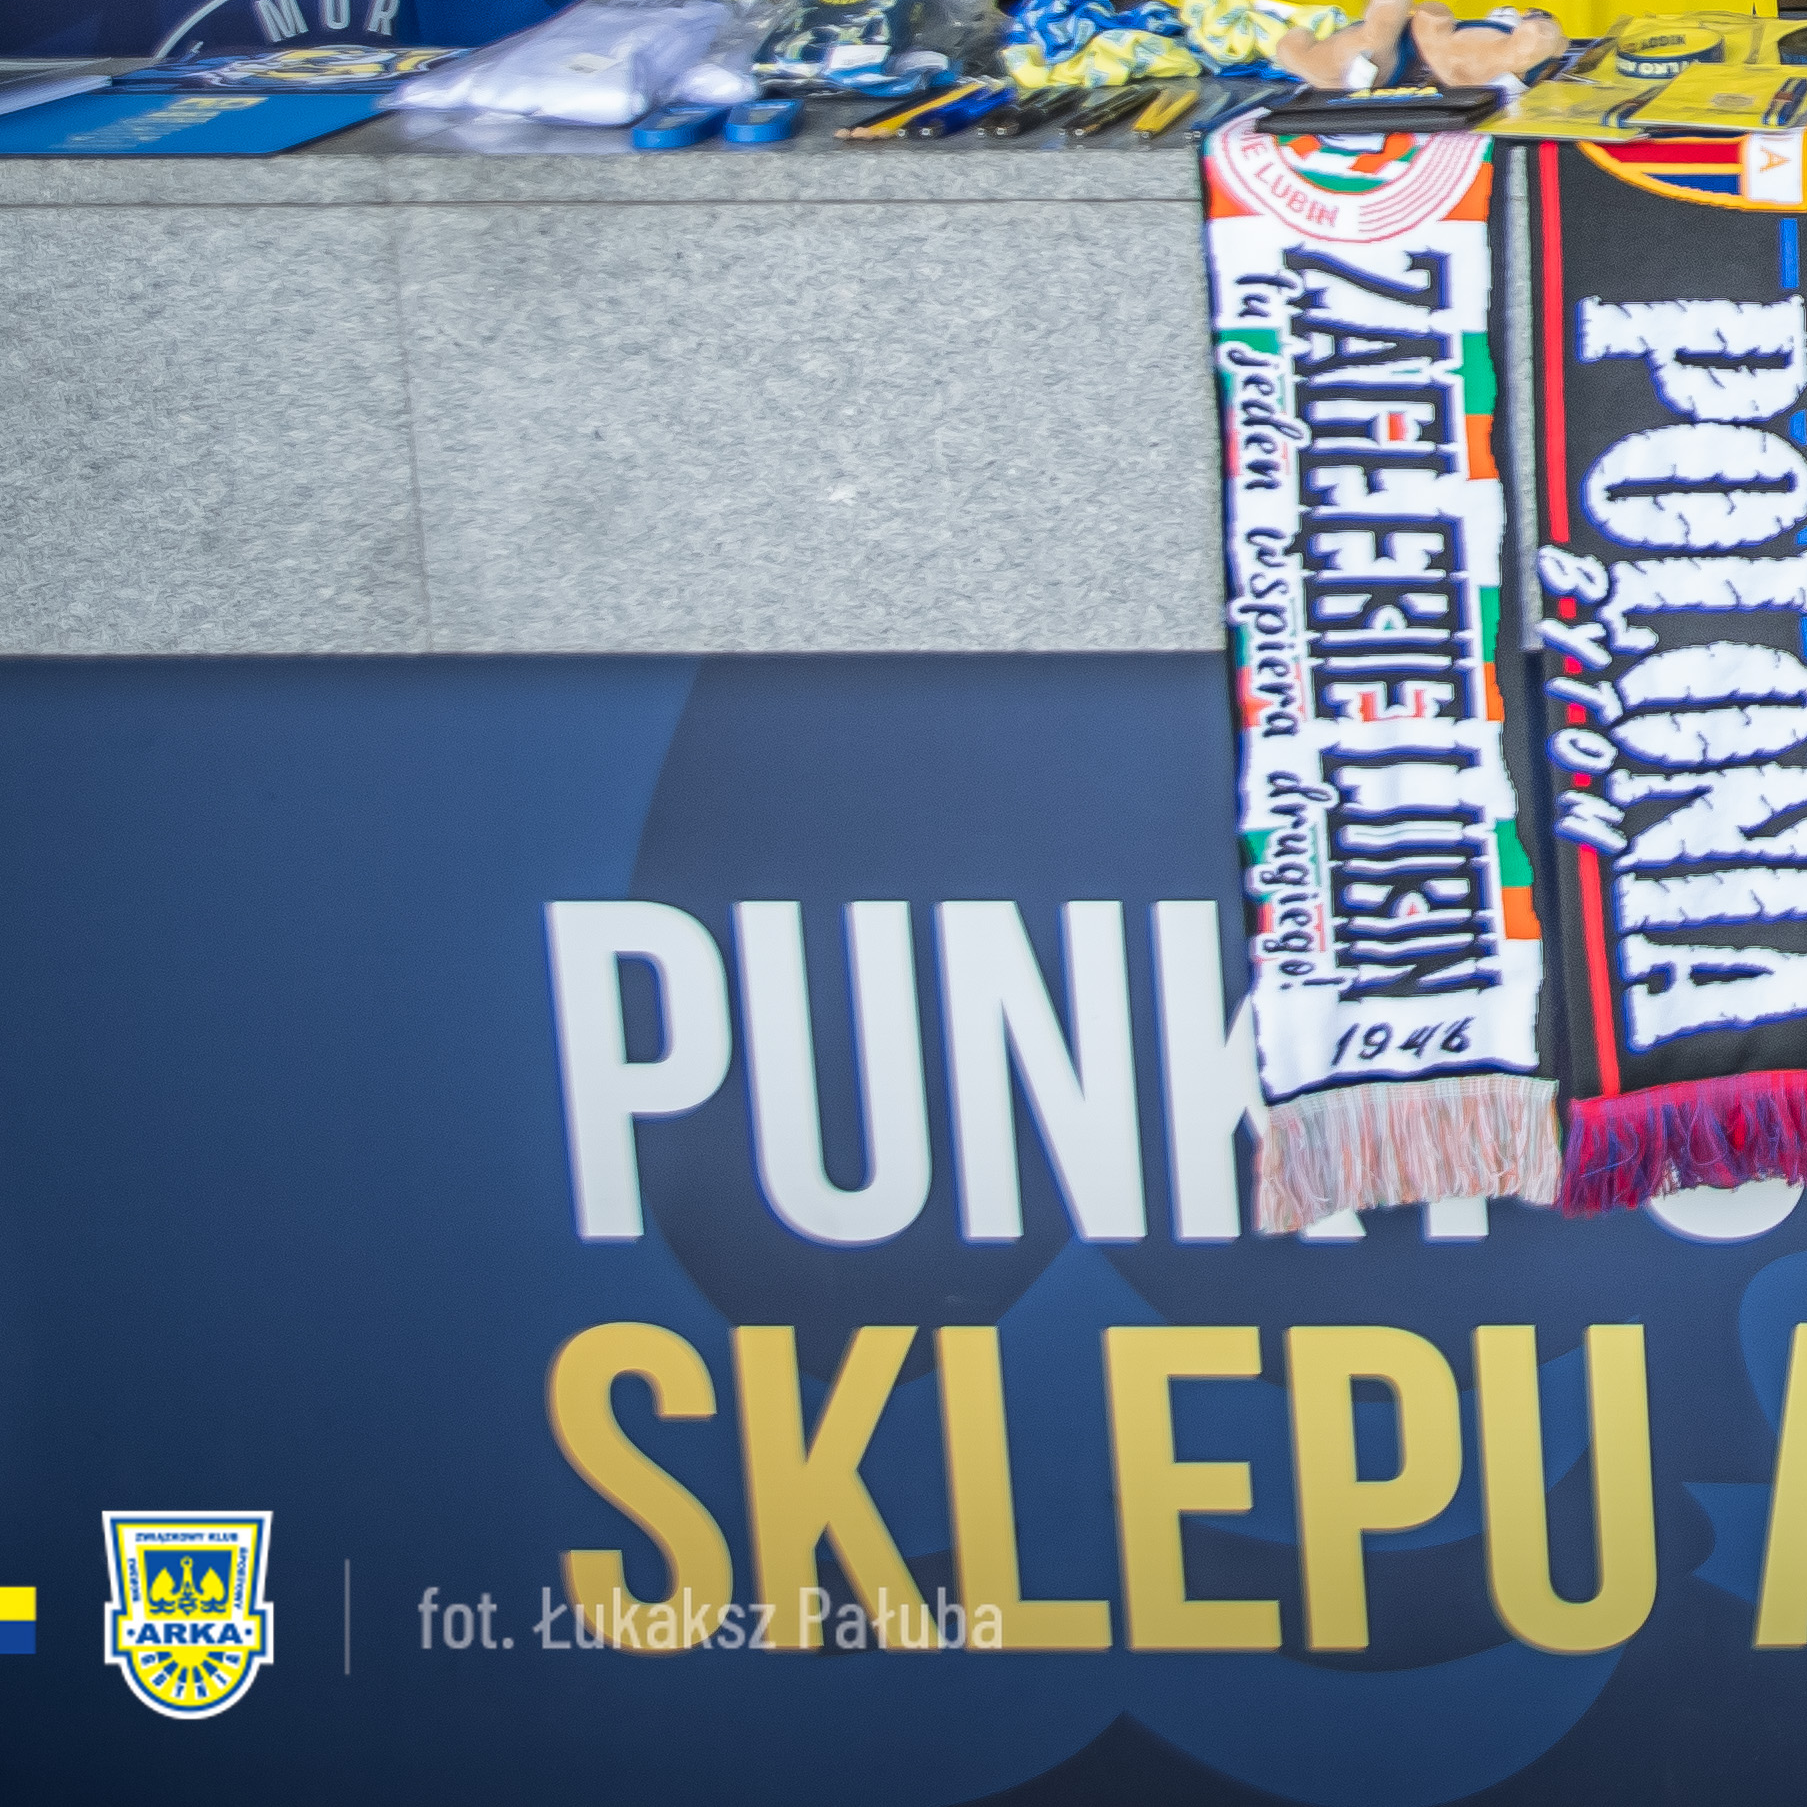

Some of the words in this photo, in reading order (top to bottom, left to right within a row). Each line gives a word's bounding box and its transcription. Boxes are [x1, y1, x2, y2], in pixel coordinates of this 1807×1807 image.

[1257, 155, 1339, 229] LUBIN
[1232, 272, 1298, 319] tu
[1228, 345, 1311, 490] jeden
[1240, 529, 1302, 739] wspiera
[1262, 770, 1339, 990] drugiego!
[1319, 742, 1500, 989] LUBIN
[1331, 1016, 1475, 1064] 1946
[550, 1316, 1657, 1657] SKLEPU
